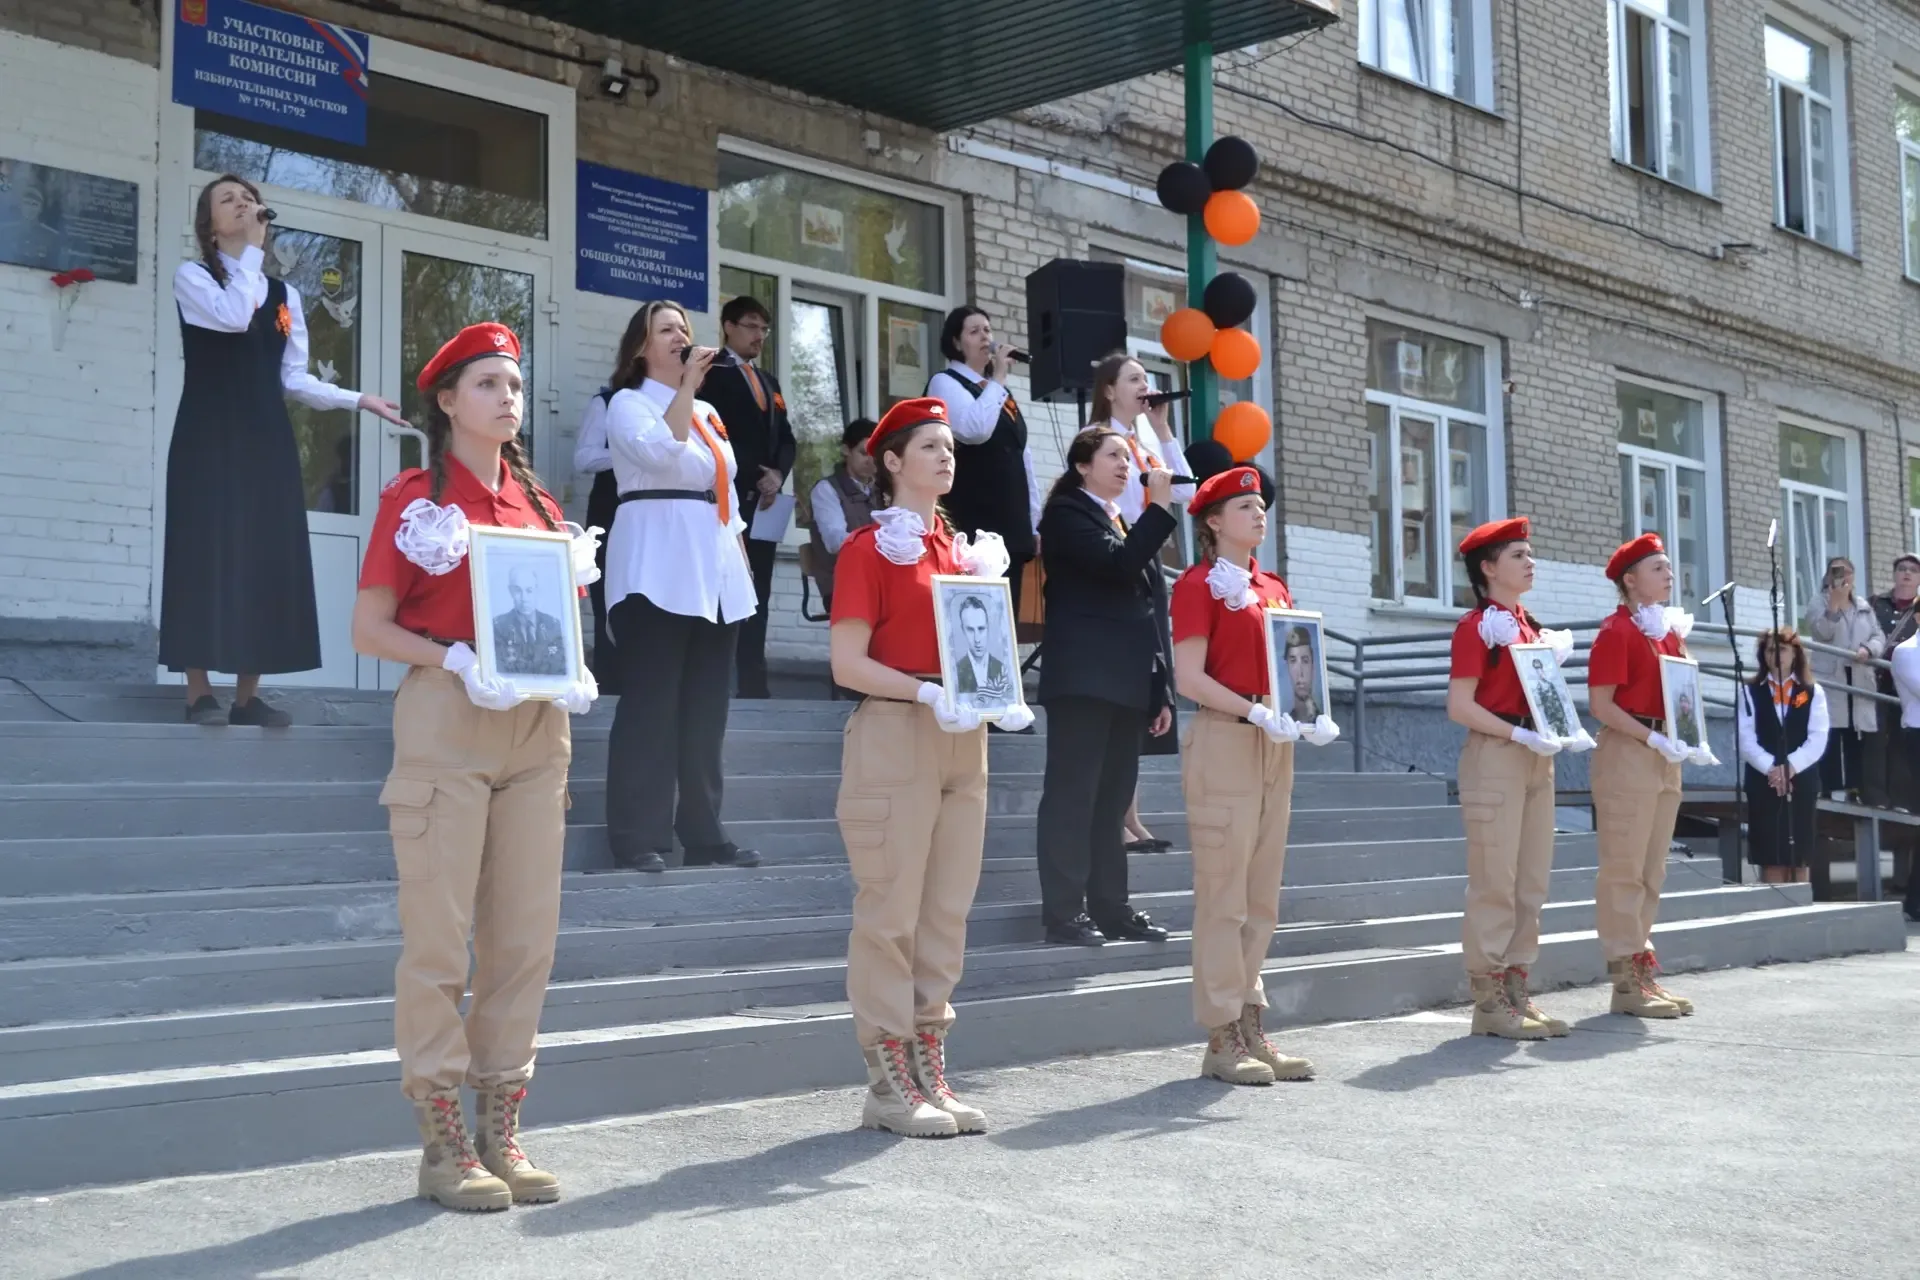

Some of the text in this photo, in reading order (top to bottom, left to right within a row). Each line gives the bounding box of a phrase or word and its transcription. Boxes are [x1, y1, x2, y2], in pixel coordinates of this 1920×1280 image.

[223, 16, 325, 54] УЧАСТКОВЫЕ
[207, 30, 340, 75] ИЗБИРАТЕЛЬНЫЕ
[229, 53, 317, 87] КОМИССИИ
[194, 68, 349, 115] ИЗБИРАТЕЛЬНЫХ УЧАСТКОВ
[238, 93, 306, 118] № 1791, 1792
[580, 247, 705, 281] ОБЩЕОБРАЗОВАТЕЛЬНАЯ
[610, 267, 649, 284] ШКОЛА
